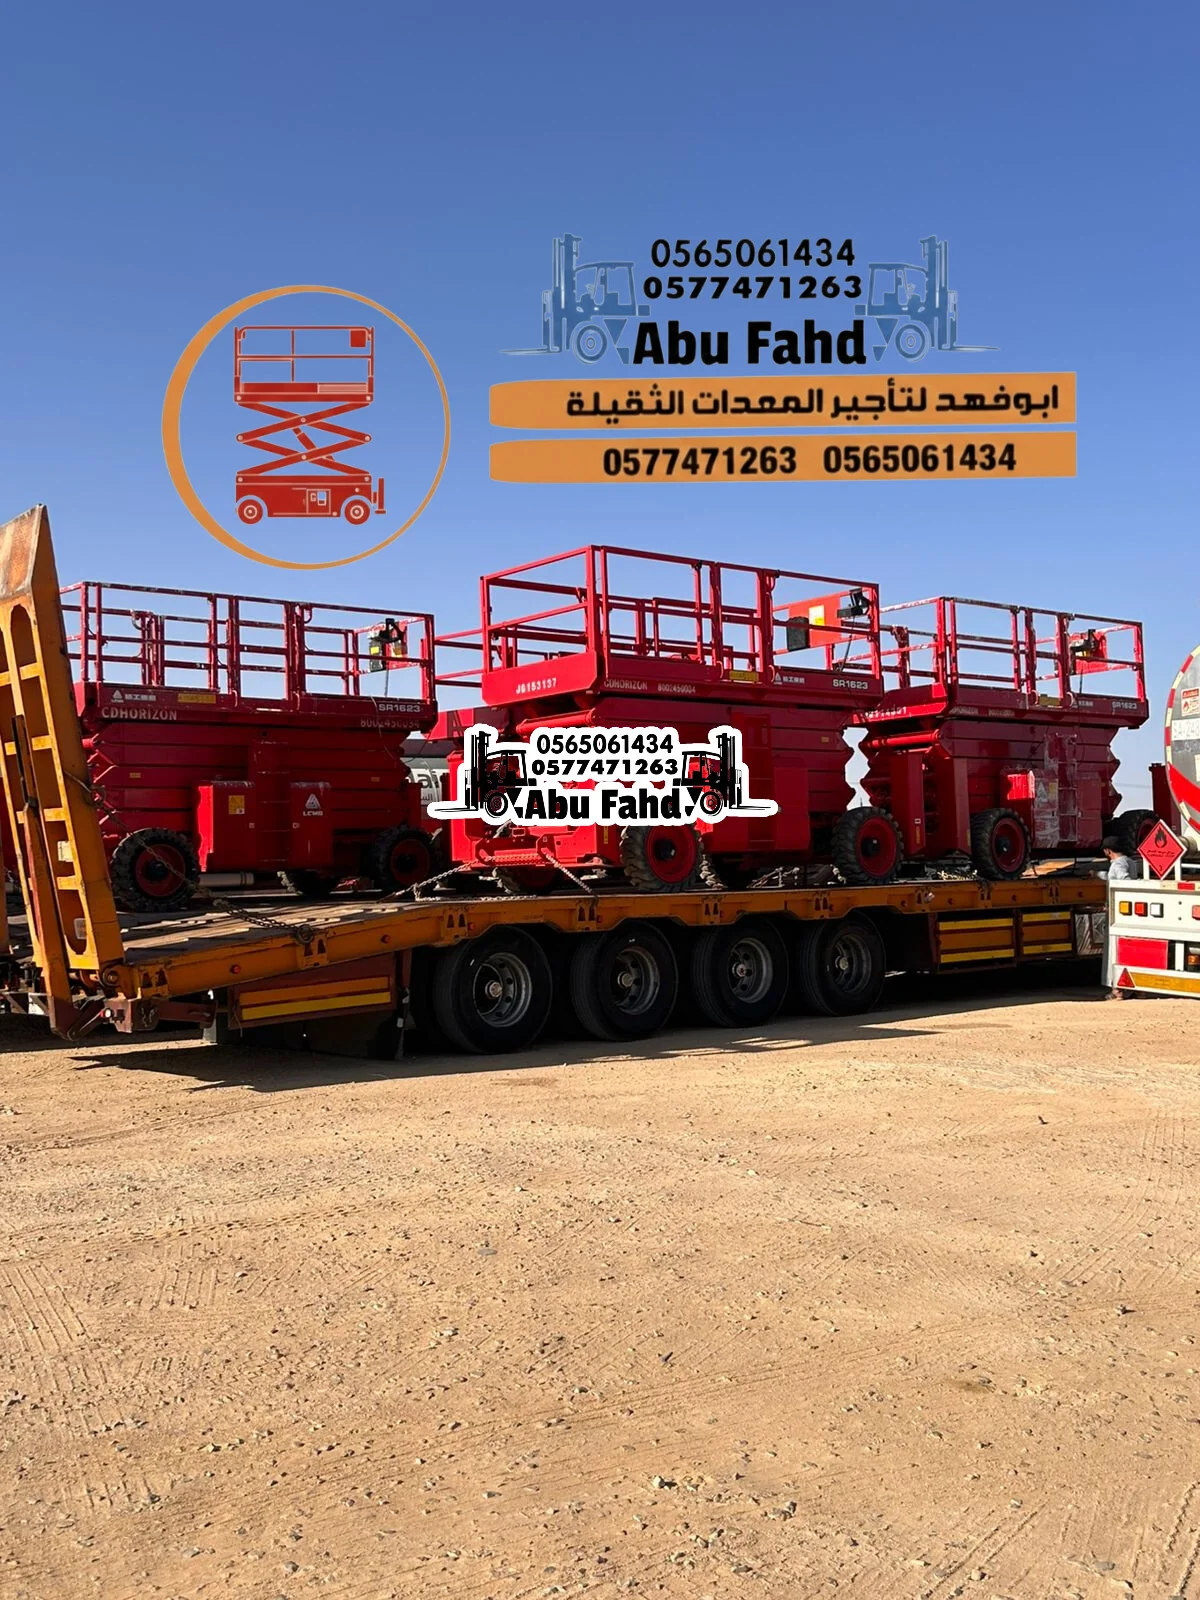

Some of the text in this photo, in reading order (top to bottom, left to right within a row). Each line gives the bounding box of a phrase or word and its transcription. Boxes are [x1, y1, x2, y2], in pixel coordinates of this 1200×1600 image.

[833, 679, 869, 690] SR1623
[101, 706, 178, 721] CDHORIZON
[378, 703, 421, 713] SR1623
